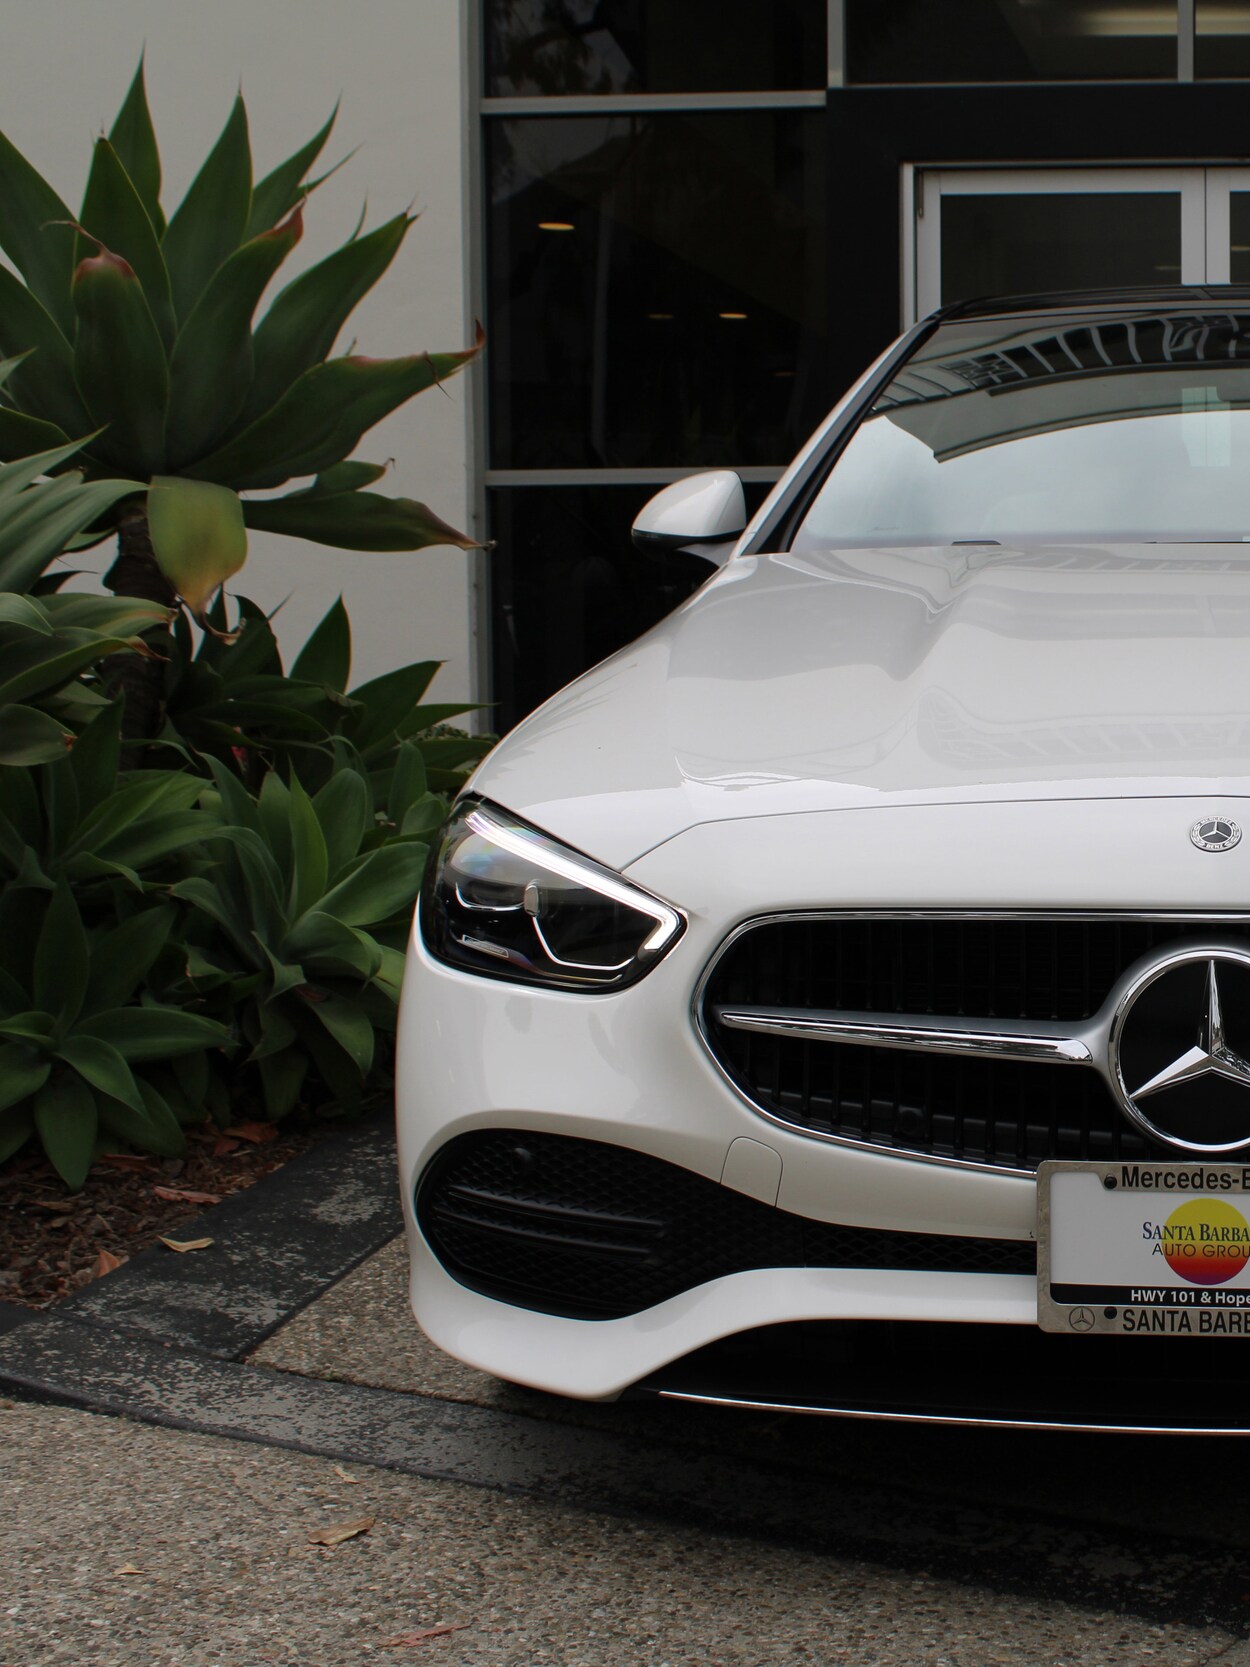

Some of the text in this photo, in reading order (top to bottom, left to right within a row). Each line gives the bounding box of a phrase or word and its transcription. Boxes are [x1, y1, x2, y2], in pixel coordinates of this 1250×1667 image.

[1142, 1221, 1196, 1241] SANTA
[1152, 1243, 1197, 1257] AUTO
[1130, 1289, 1167, 1303] HWY
[1170, 1290, 1196, 1303] 101
[1200, 1291, 1212, 1304] &
[1122, 1309, 1192, 1333] SANTA
